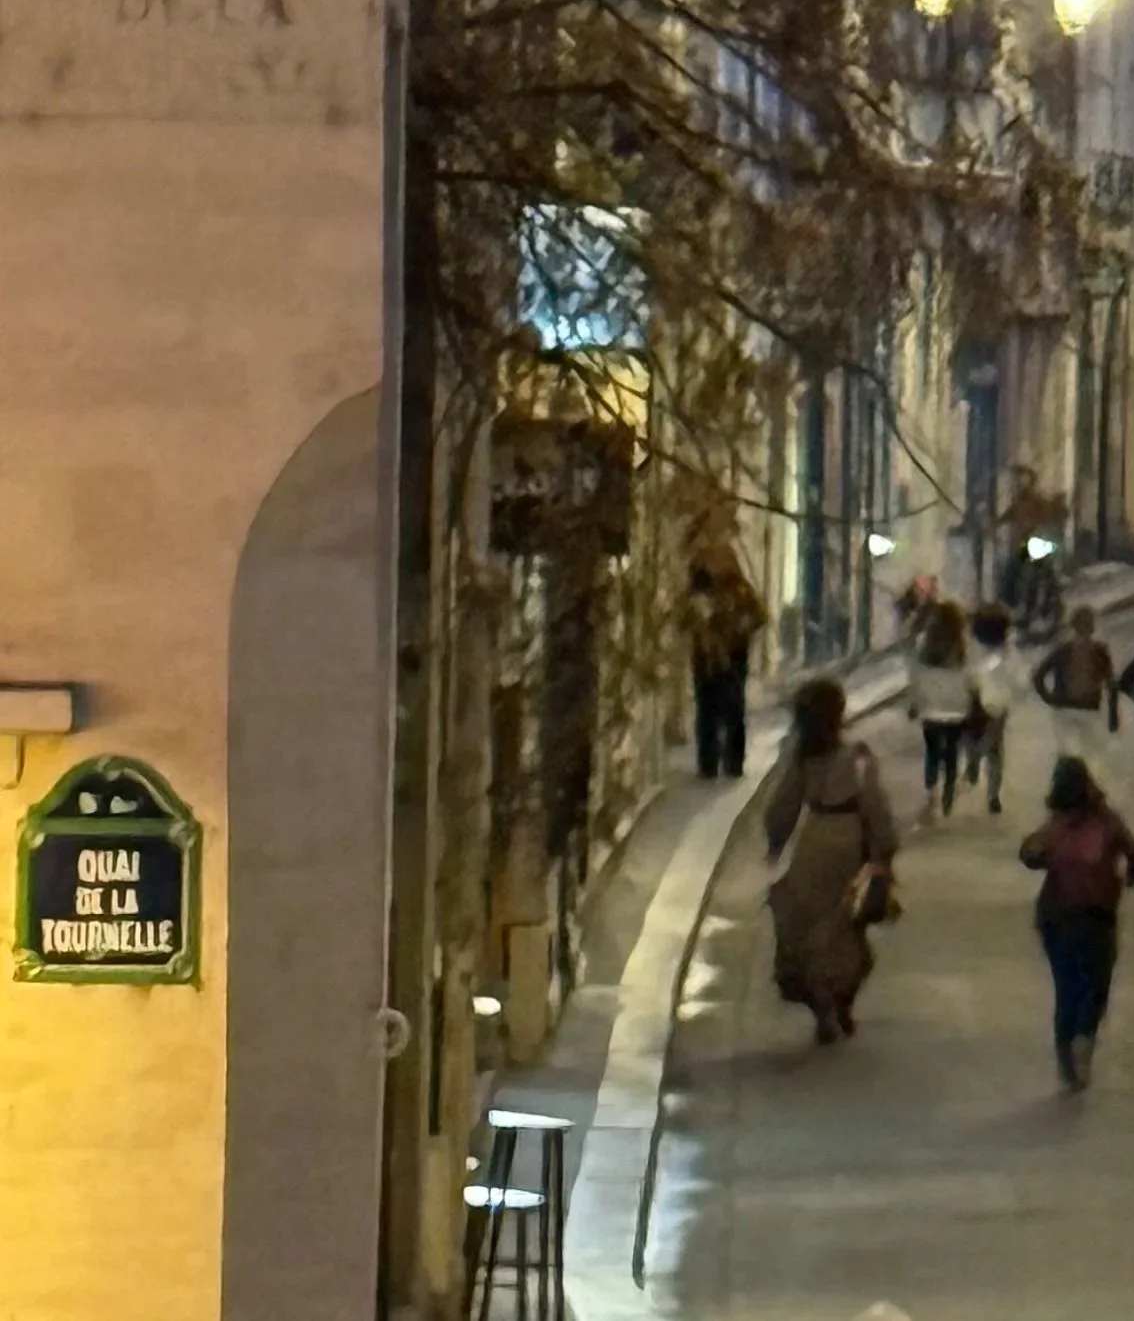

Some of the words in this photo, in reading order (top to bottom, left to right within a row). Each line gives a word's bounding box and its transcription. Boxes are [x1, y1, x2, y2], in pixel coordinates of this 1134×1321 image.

[77, 849, 140, 882] QUAI
[76, 887, 104, 915] DE
[112, 889, 139, 915] LA
[41, 919, 174, 953] TOURNELLE
